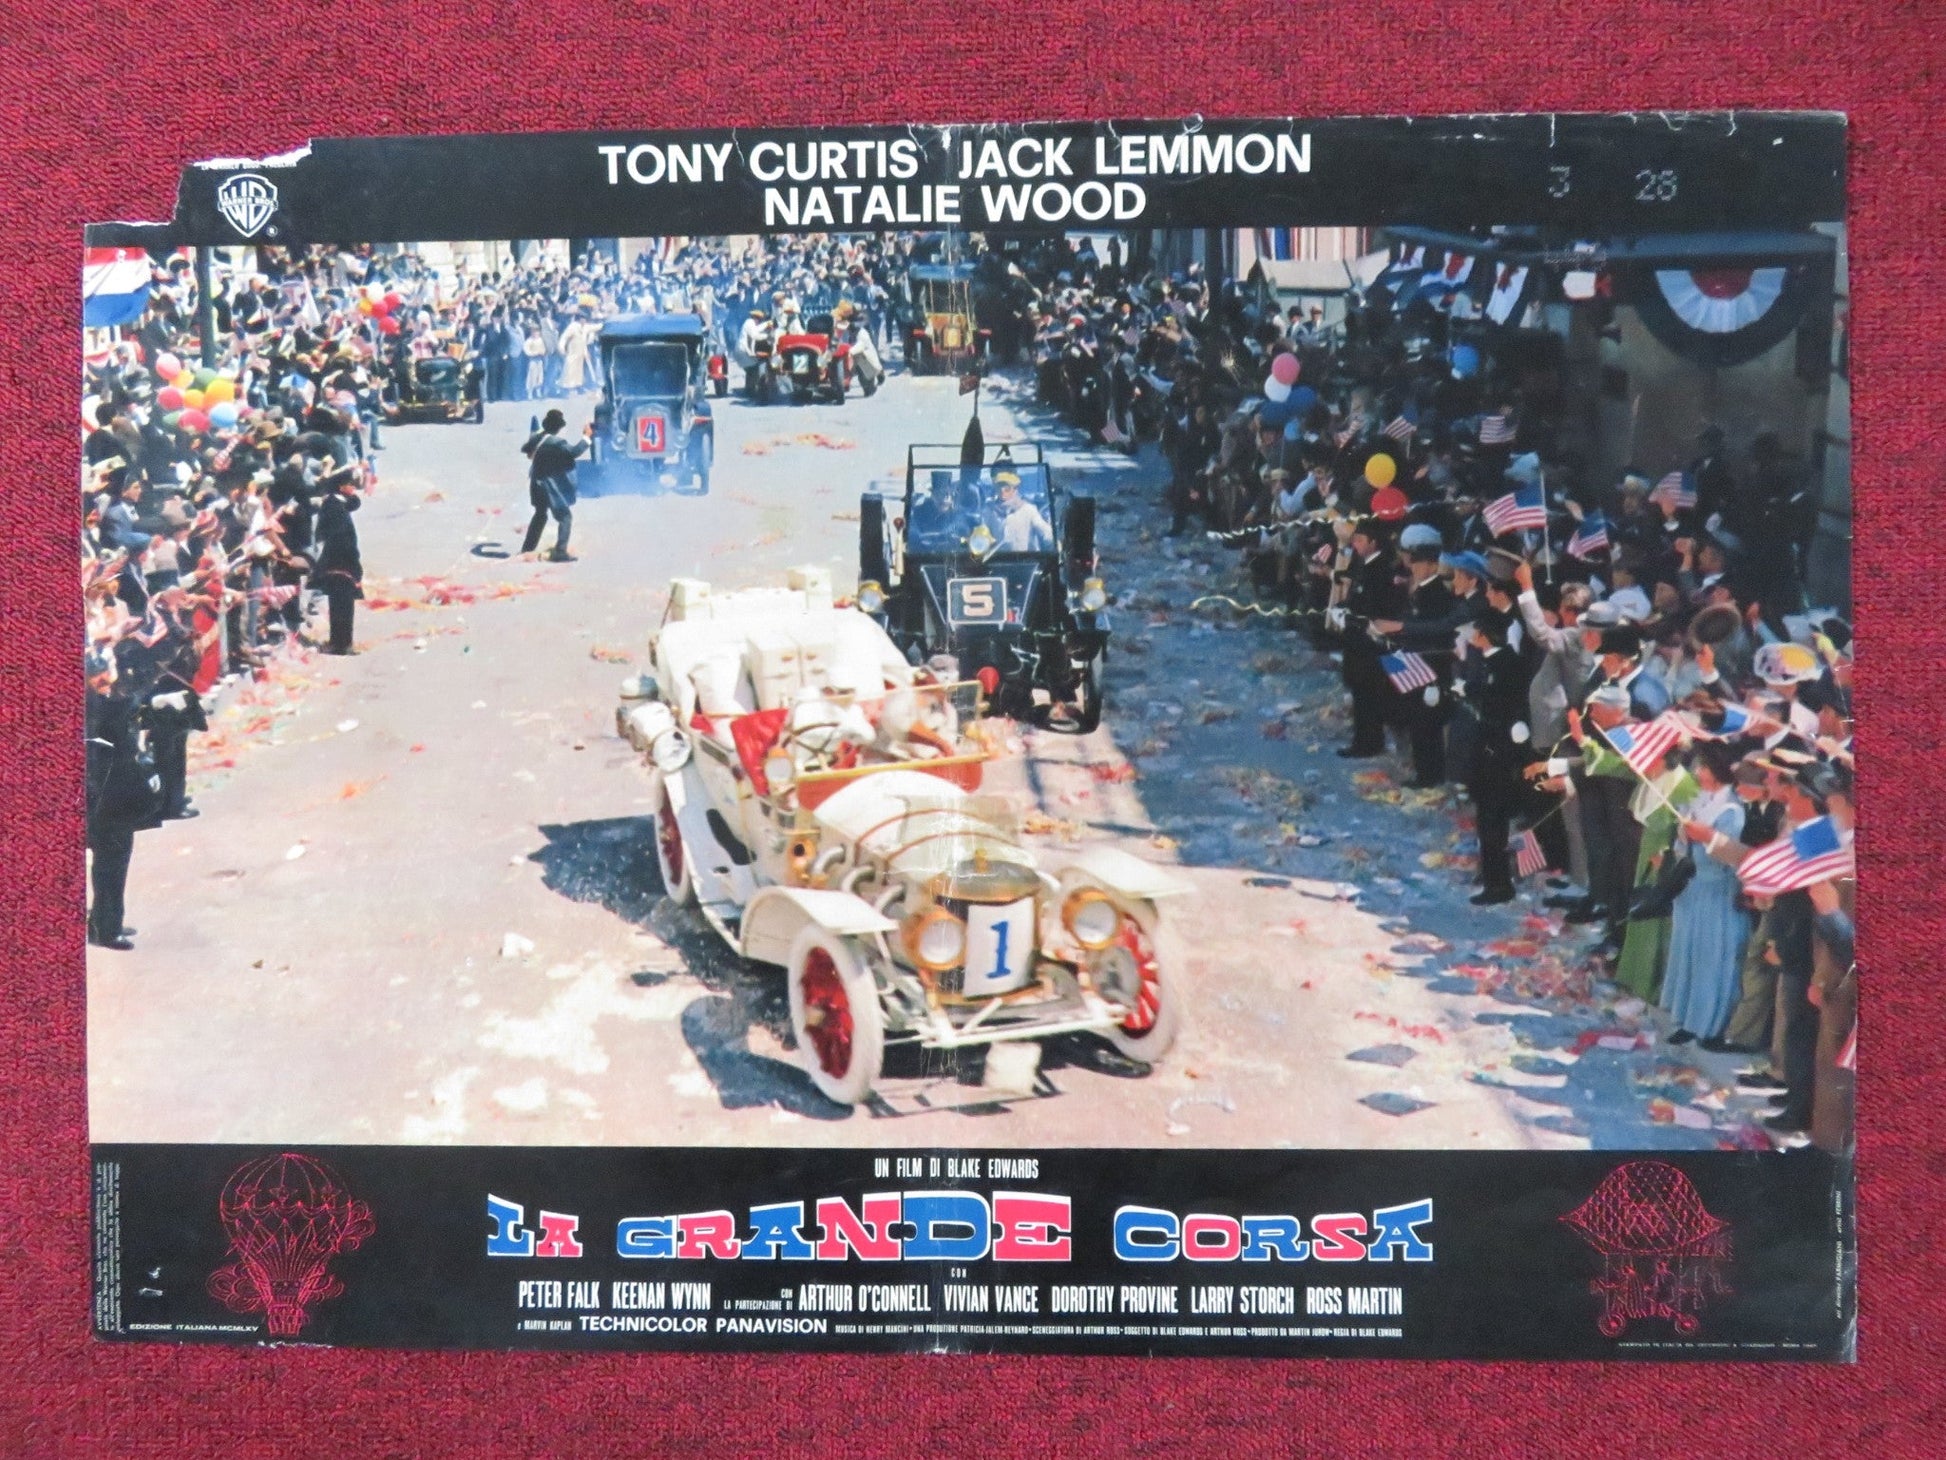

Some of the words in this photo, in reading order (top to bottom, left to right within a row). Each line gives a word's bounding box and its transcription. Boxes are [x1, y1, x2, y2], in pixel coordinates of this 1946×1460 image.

[599, 143, 733, 184] TONY
[750, 139, 919, 182] CURTIS
[958, 137, 1074, 179] JACK
[1096, 133, 1312, 176] LEMMON
[764, 185, 961, 226] NATALIE
[981, 181, 1147, 222] WOOD
[643, 421, 659, 447] 4
[961, 584, 994, 617] 5
[986, 920, 1012, 979] 1
[874, 1158, 890, 1178] UN
[896, 1158, 923, 1178] FILM
[930, 1158, 941, 1178] DI
[947, 1158, 981, 1178] BLAKE
[988, 1158, 1039, 1179] EDWARDS
[487, 1193, 583, 1258] LA
[616, 1190, 1072, 1262] GRANDE
[1113, 1198, 1433, 1262] CORSA
[518, 1280, 562, 1309] PETER
[567, 1281, 600, 1309] FALK
[612, 1282, 665, 1310] KEENAN
[671, 1282, 711, 1311] WYNN
[723, 1300, 732, 1310] LA
[798, 1284, 853, 1312] ARTHUR
[858, 1284, 931, 1312] O'CONNELL
[944, 1284, 989, 1313] VIVIAN
[995, 1285, 1039, 1313] VANCE
[1051, 1286, 1114, 1314] DOROTHY
[1121, 1286, 1179, 1314] PROVINE
[1190, 1286, 1234, 1314] LARRY
[1240, 1287, 1294, 1315] STORCH
[1306, 1287, 1342, 1315] ROSS
[1348, 1287, 1403, 1315] MARTIN
[129, 1323, 172, 1331] EDIZIONE
[176, 1323, 218, 1332] ITALIANA
[579, 1316, 707, 1332] TECHNICOLOR
[716, 1318, 827, 1333] PANAVISION
